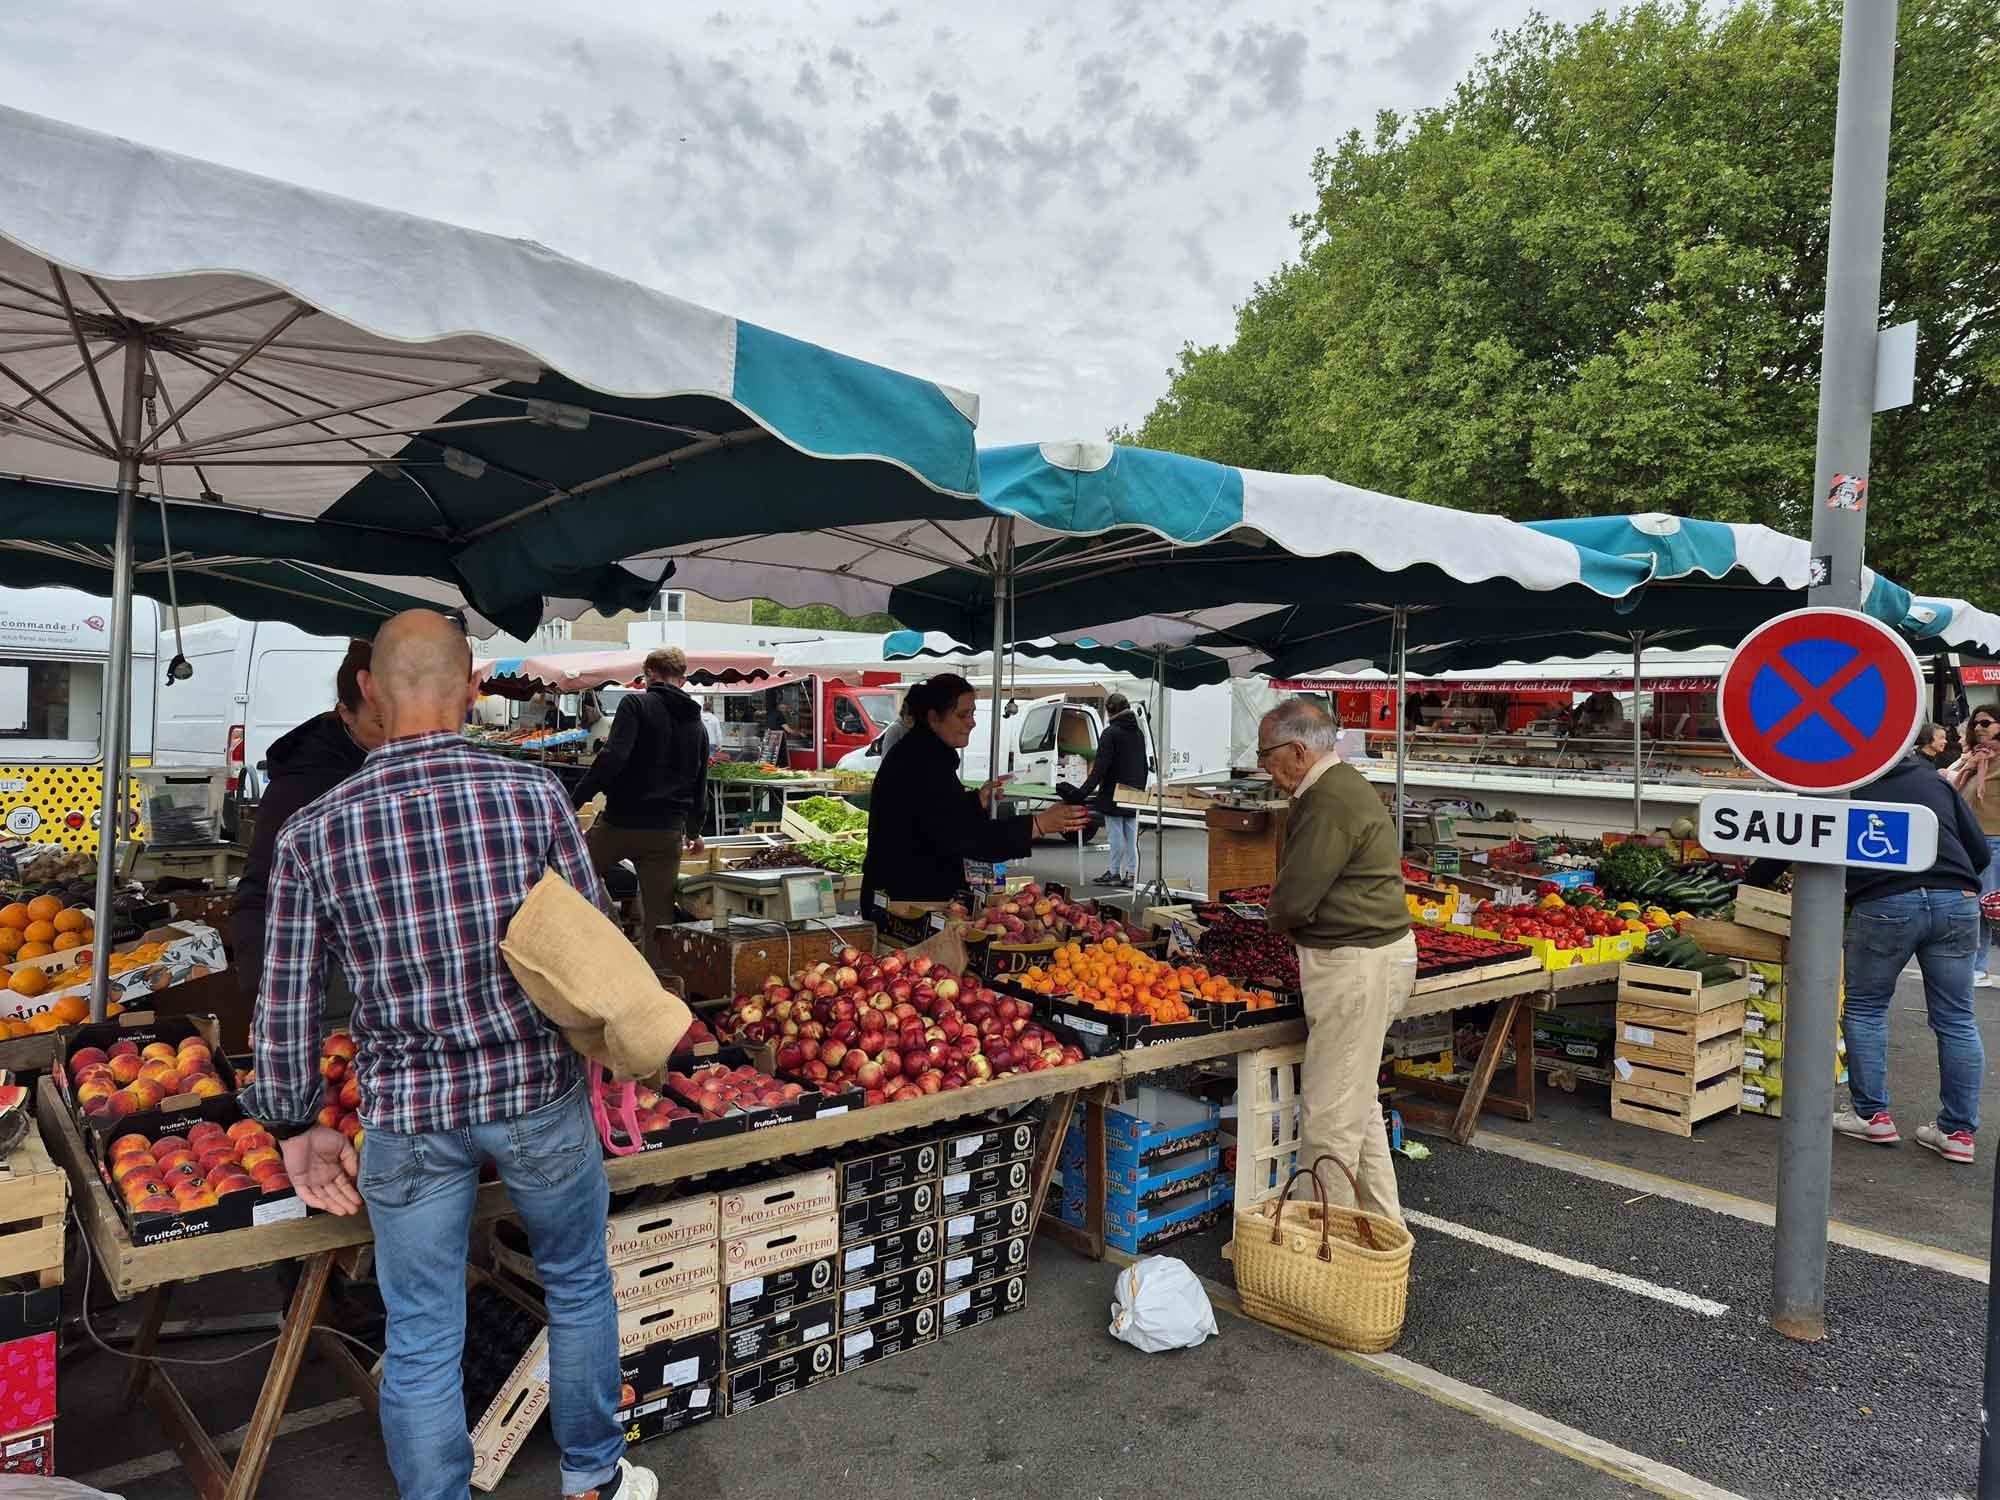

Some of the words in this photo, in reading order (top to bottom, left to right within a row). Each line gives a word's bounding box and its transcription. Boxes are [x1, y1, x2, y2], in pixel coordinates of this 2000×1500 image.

[1462, 681, 1496, 692] Cochon
[1499, 682, 1510, 691] de
[1713, 807, 1836, 848] SAUF
[160, 1122, 186, 1132] fruites
[187, 1117, 203, 1125] font
[754, 1118, 777, 1128] fruites
[778, 1115, 793, 1123] font
[646, 1141, 663, 1150] font
[741, 1213, 763, 1225] PACO
[777, 1195, 831, 1215] CONFITERO
[144, 1227, 184, 1243] fruites
[184, 1221, 209, 1232] font
[611, 1240, 637, 1255] PACO
[653, 1222, 713, 1244] CONFITERO
[744, 1257, 767, 1269] PACO
[780, 1238, 833, 1259] CONFITERO
[615, 1286, 639, 1300] PACO
[655, 1265, 713, 1289] CONFITERO
[620, 1332, 639, 1346] ACO
[655, 1311, 713, 1335] CONFITERO
[623, 1367, 639, 1378] font
[493, 1432, 516, 1462] PACO
